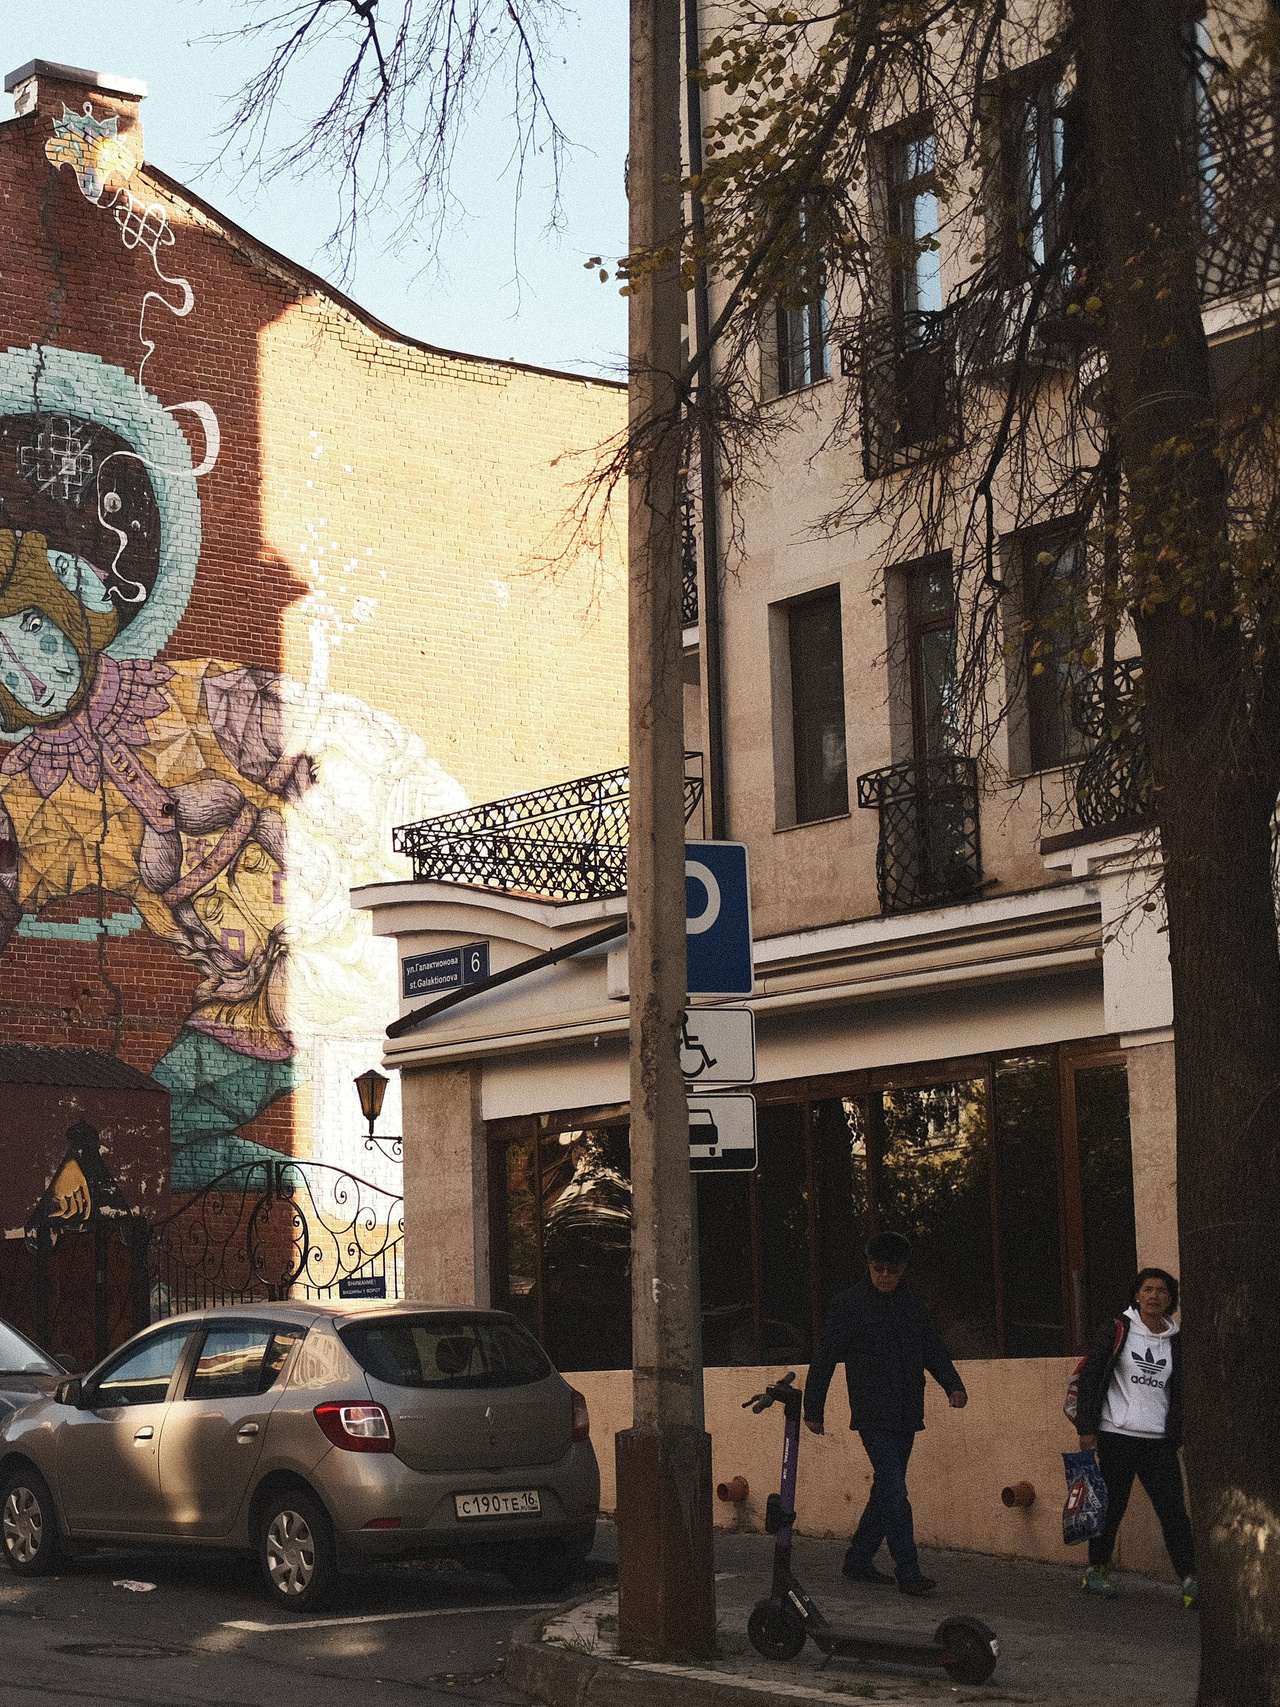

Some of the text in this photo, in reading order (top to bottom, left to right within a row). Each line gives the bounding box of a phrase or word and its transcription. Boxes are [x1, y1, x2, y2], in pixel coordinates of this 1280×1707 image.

[406, 957, 459, 976] ул.Галактионова
[471, 952, 480, 973] 6
[409, 973, 458, 990] st.Galaktionova
[521, 1492, 535, 1505] 16
